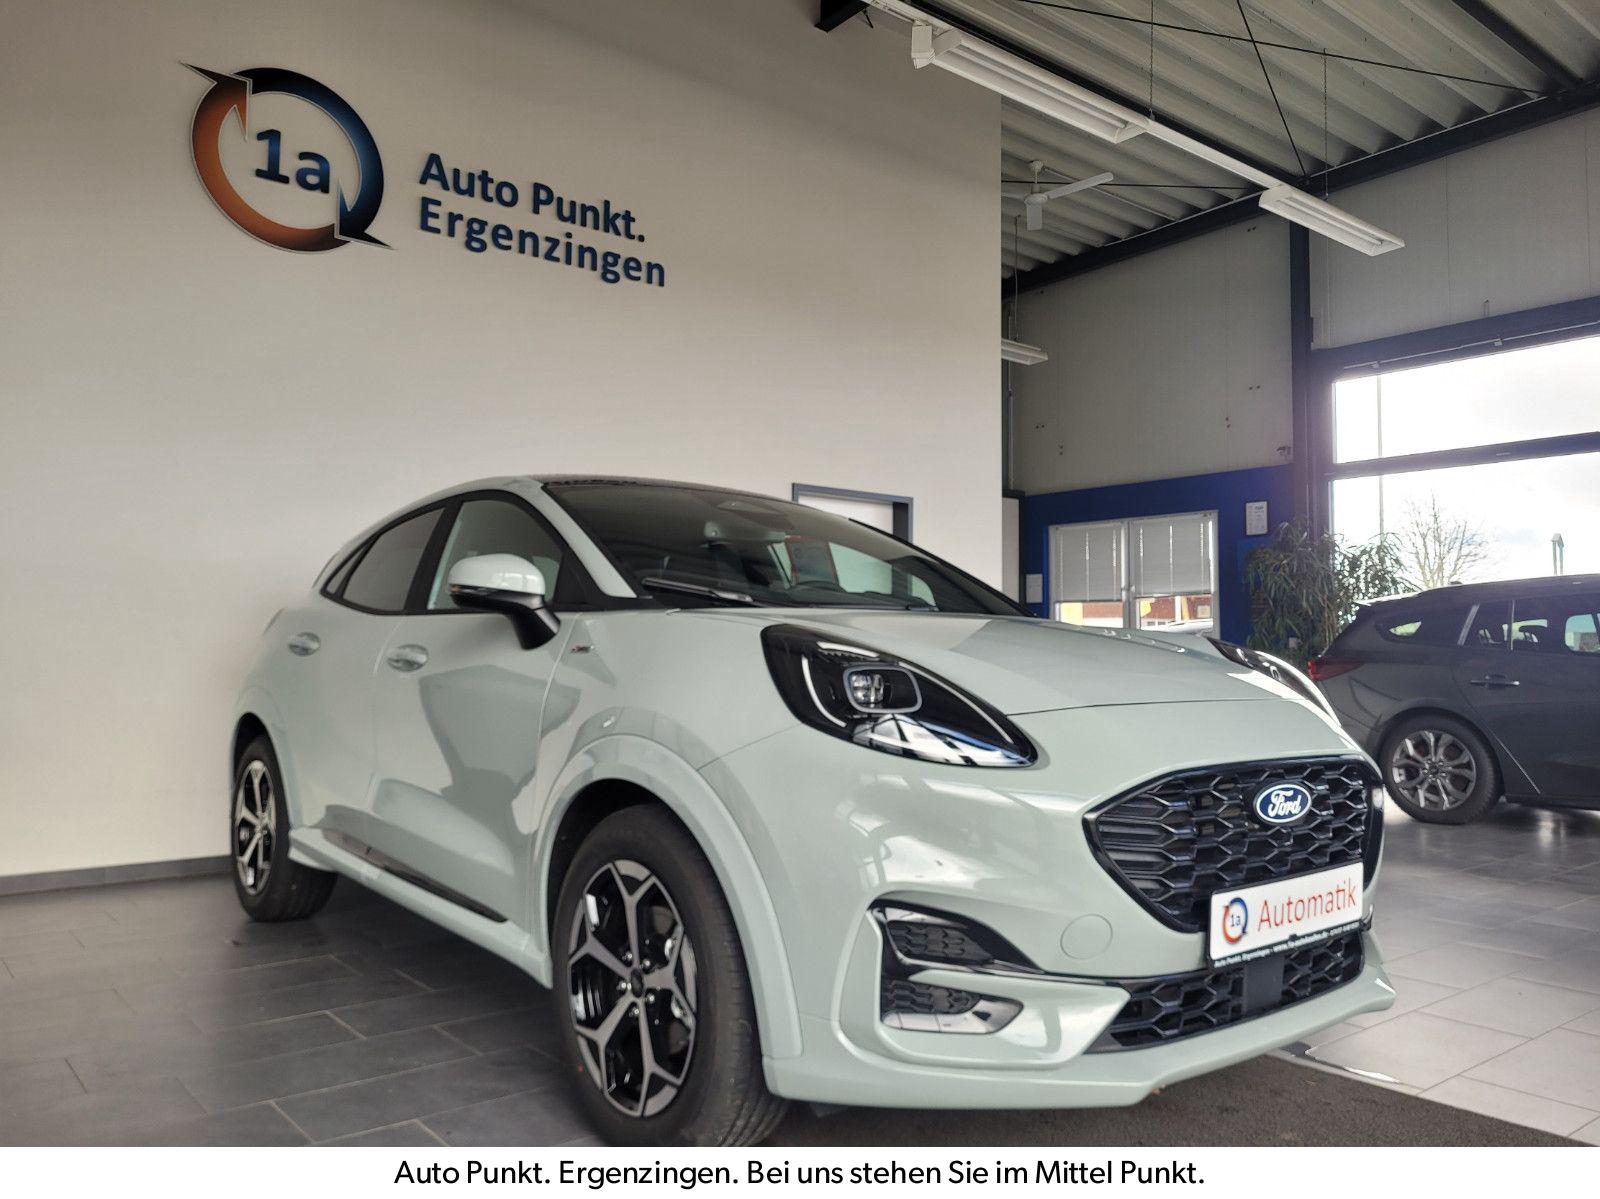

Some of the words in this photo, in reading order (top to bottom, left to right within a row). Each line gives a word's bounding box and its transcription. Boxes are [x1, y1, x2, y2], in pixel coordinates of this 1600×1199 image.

[254, 128, 331, 194] 1a
[419, 152, 519, 208] Auto
[532, 182, 645, 243] Punkt.
[419, 196, 665, 287] Ergenzingen
[1268, 790, 1302, 817] Ford
[1230, 914, 1241, 927] 1a
[1258, 877, 1356, 932] Automatik
